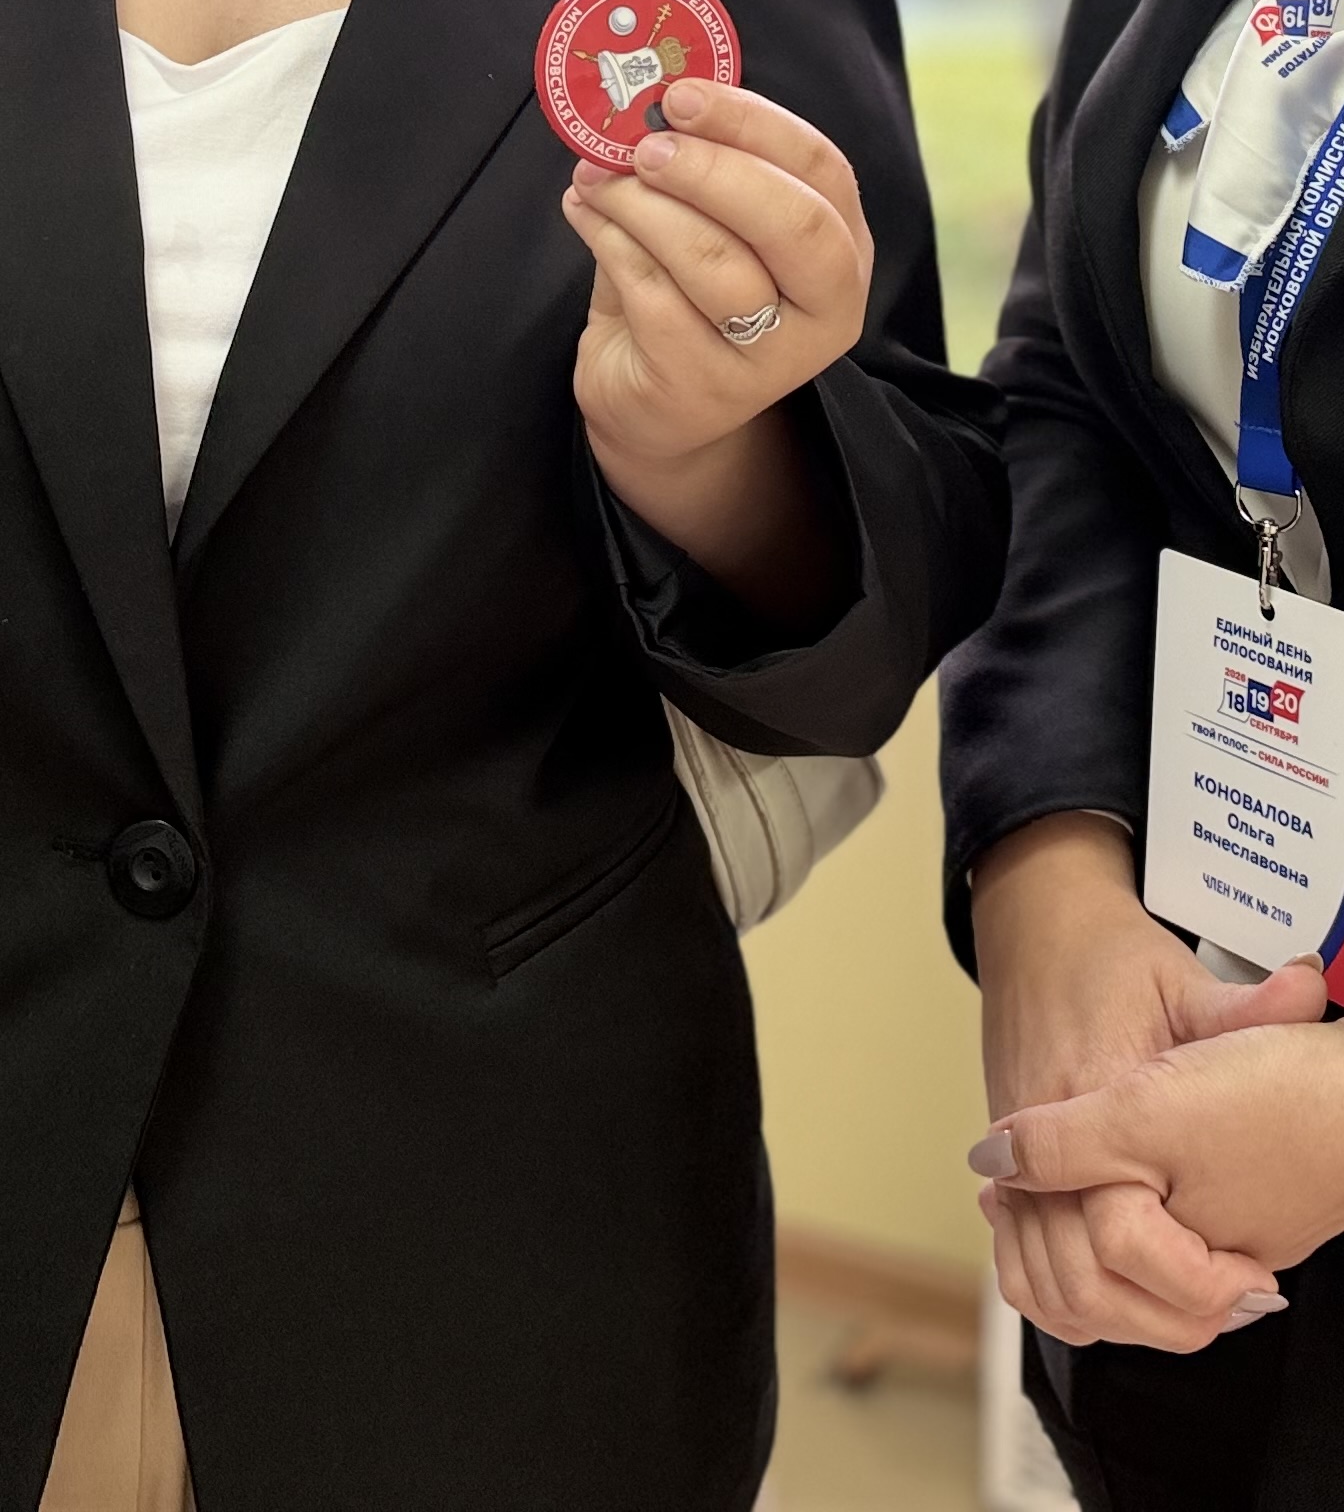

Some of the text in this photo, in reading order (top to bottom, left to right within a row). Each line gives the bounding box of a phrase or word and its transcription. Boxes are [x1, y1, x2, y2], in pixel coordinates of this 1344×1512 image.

[1282, 5, 1306, 28] 19
[549, 6, 635, 162] МОСКОВСКАЯ ОБЛАСТЬ
[1246, 215, 1307, 381] ИЗБИРАТЕЛЬНАЯ
[1261, 227, 1325, 364] МОСКОВСКОЙ
[1213, 634, 1313, 685] ГОЛОСОВАНИЯ
[1216, 616, 1312, 664] ЕДИНЫЙ ДЕНЬ
[1226, 688, 1298, 715] 18 19 20
[1249, 717, 1299, 746] СЕНТЯБРЯ
[1258, 750, 1285, 769] СИЛА
[1286, 762, 1329, 789] РОССИИ!
[1194, 771, 1314, 839] КОНОВАЛОВА
[1227, 812, 1275, 848] Ольга
[1193, 820, 1309, 889] Вячеславовна
[1202, 872, 1293, 928] ЧЛЕН УИК № 2118
